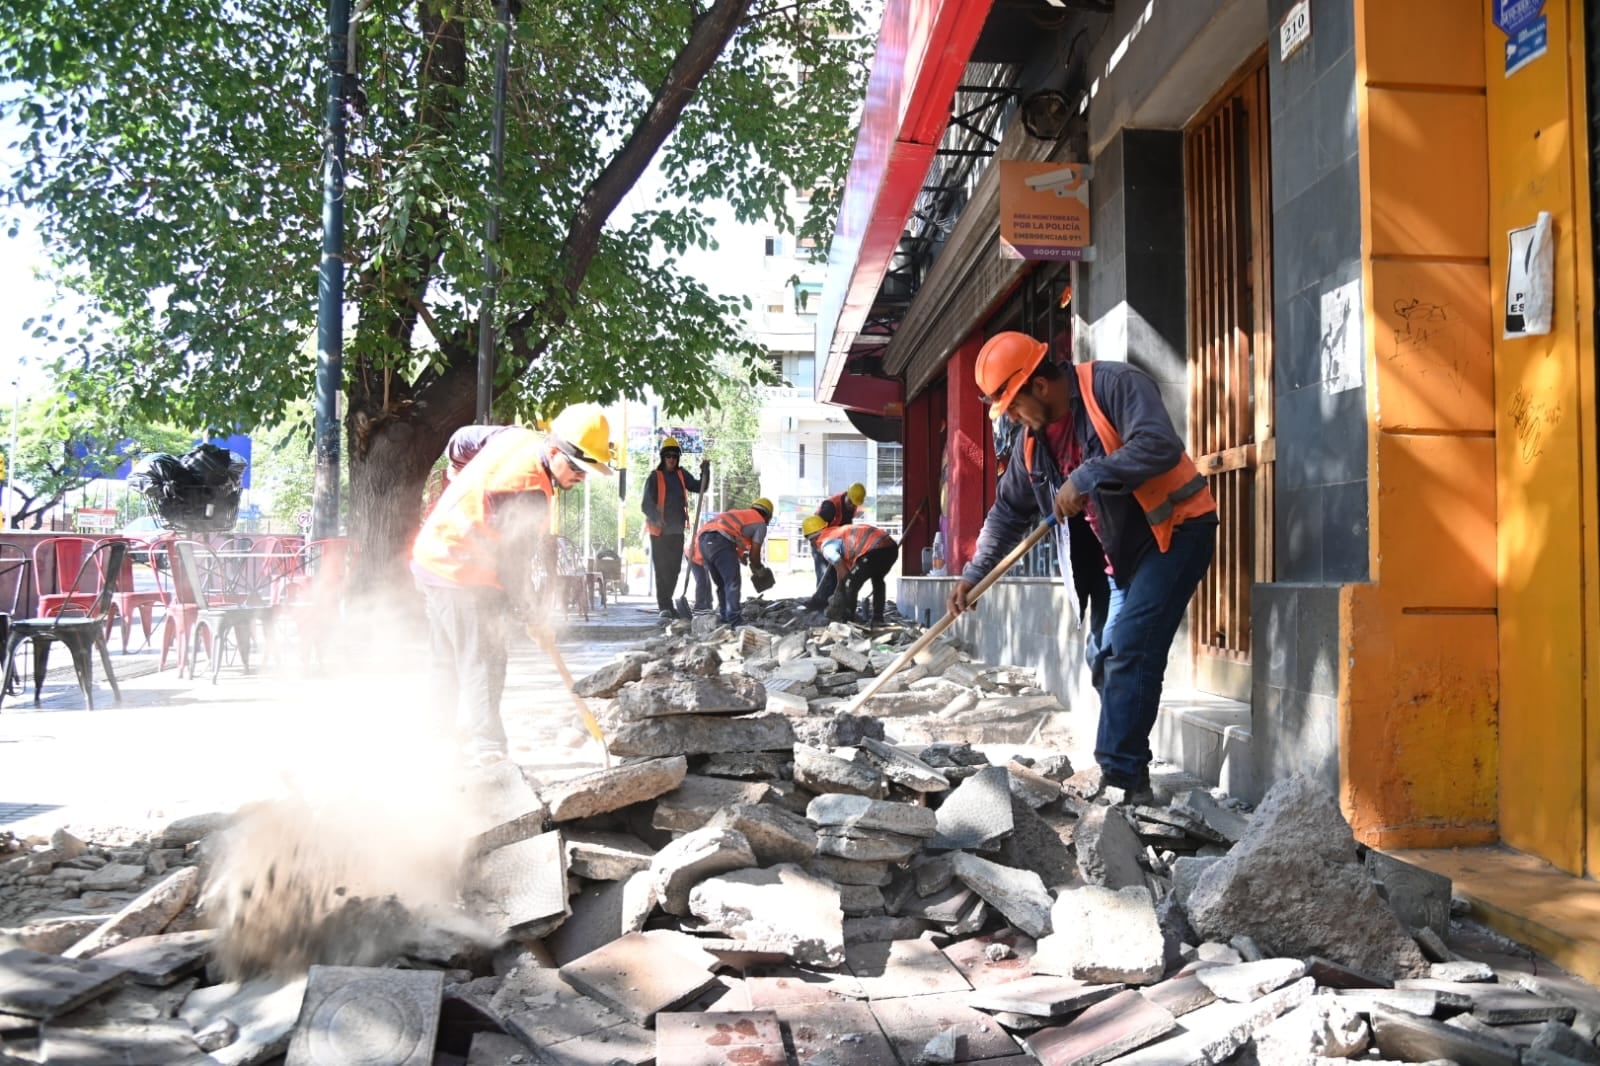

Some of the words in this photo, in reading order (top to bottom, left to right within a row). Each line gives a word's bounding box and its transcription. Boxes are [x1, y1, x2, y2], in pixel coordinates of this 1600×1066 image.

[1285, 13, 1305, 43] 210
[1046, 222, 1080, 231] POLICÍA
[1061, 249, 1081, 257] CRUZ
[1516, 293, 1526, 301] P
